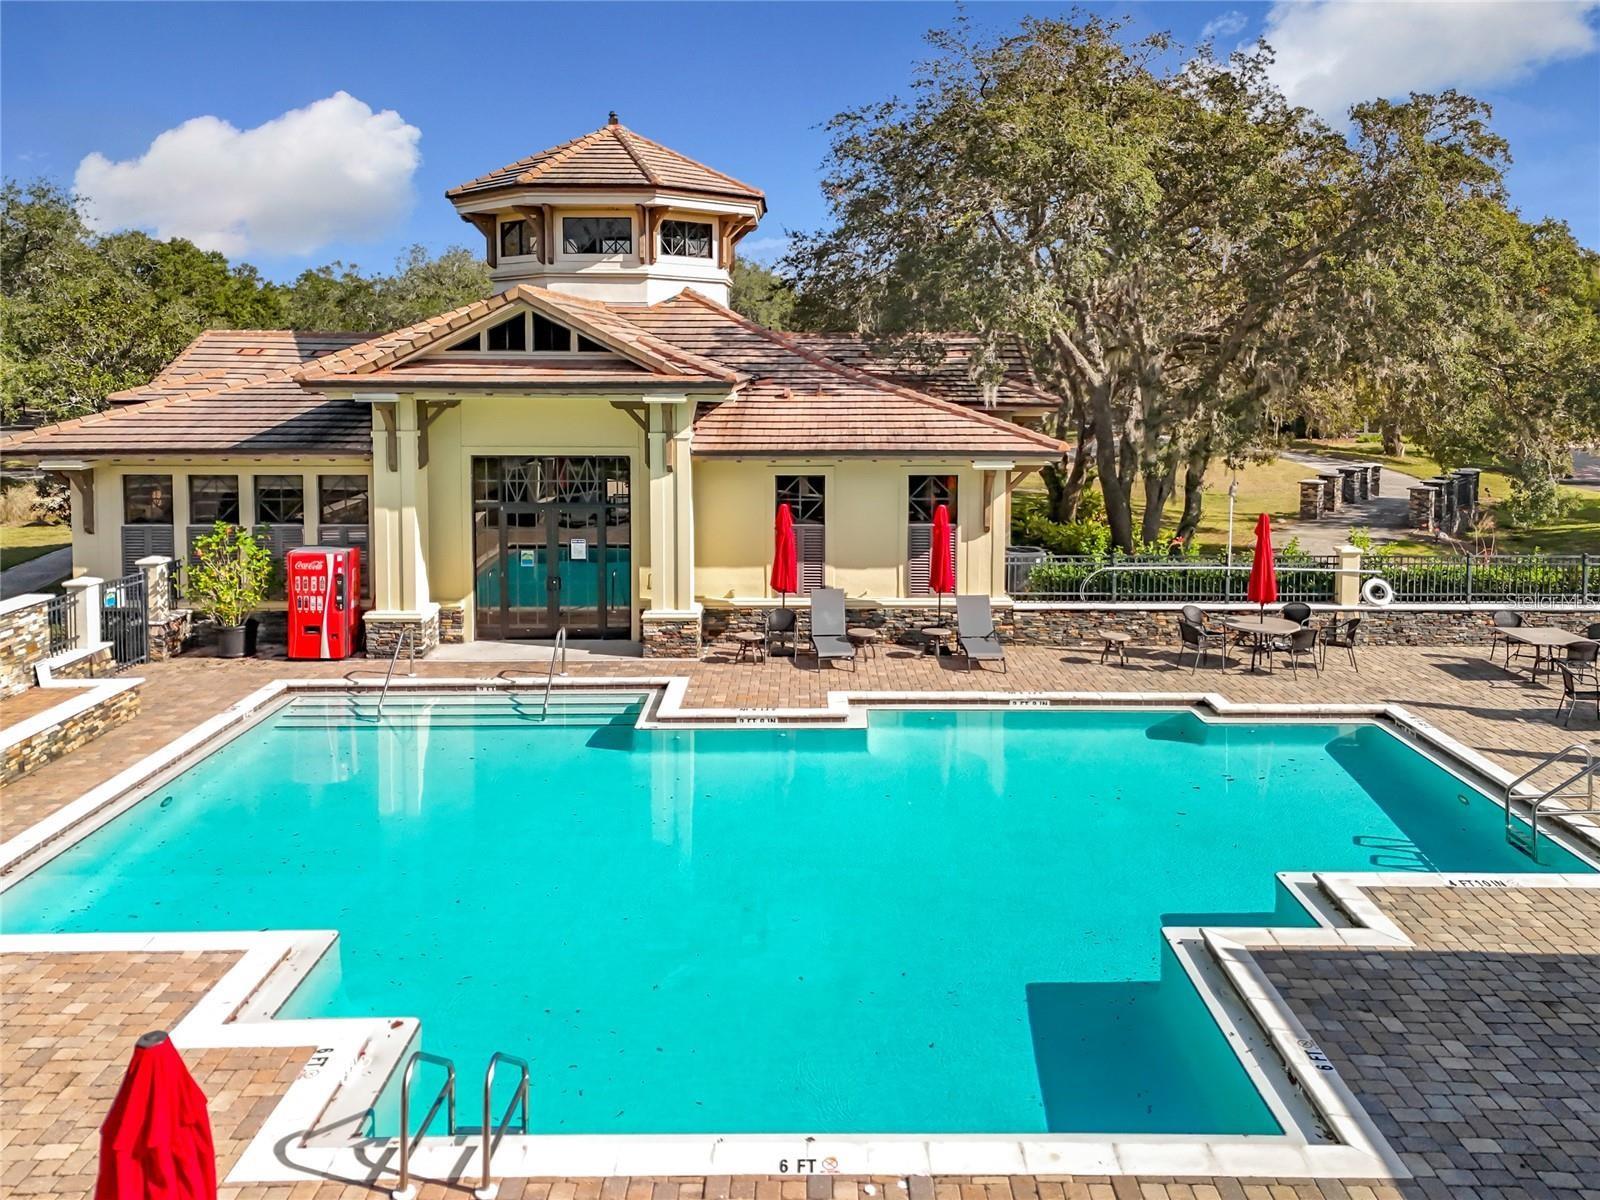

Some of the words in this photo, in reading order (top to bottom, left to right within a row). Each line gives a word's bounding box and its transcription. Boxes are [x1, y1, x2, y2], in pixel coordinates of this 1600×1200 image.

[307, 1057, 329, 1067] FT
[1303, 1050, 1328, 1062] FT
[779, 1159, 788, 1173] 6
[797, 1159, 816, 1173] FT
